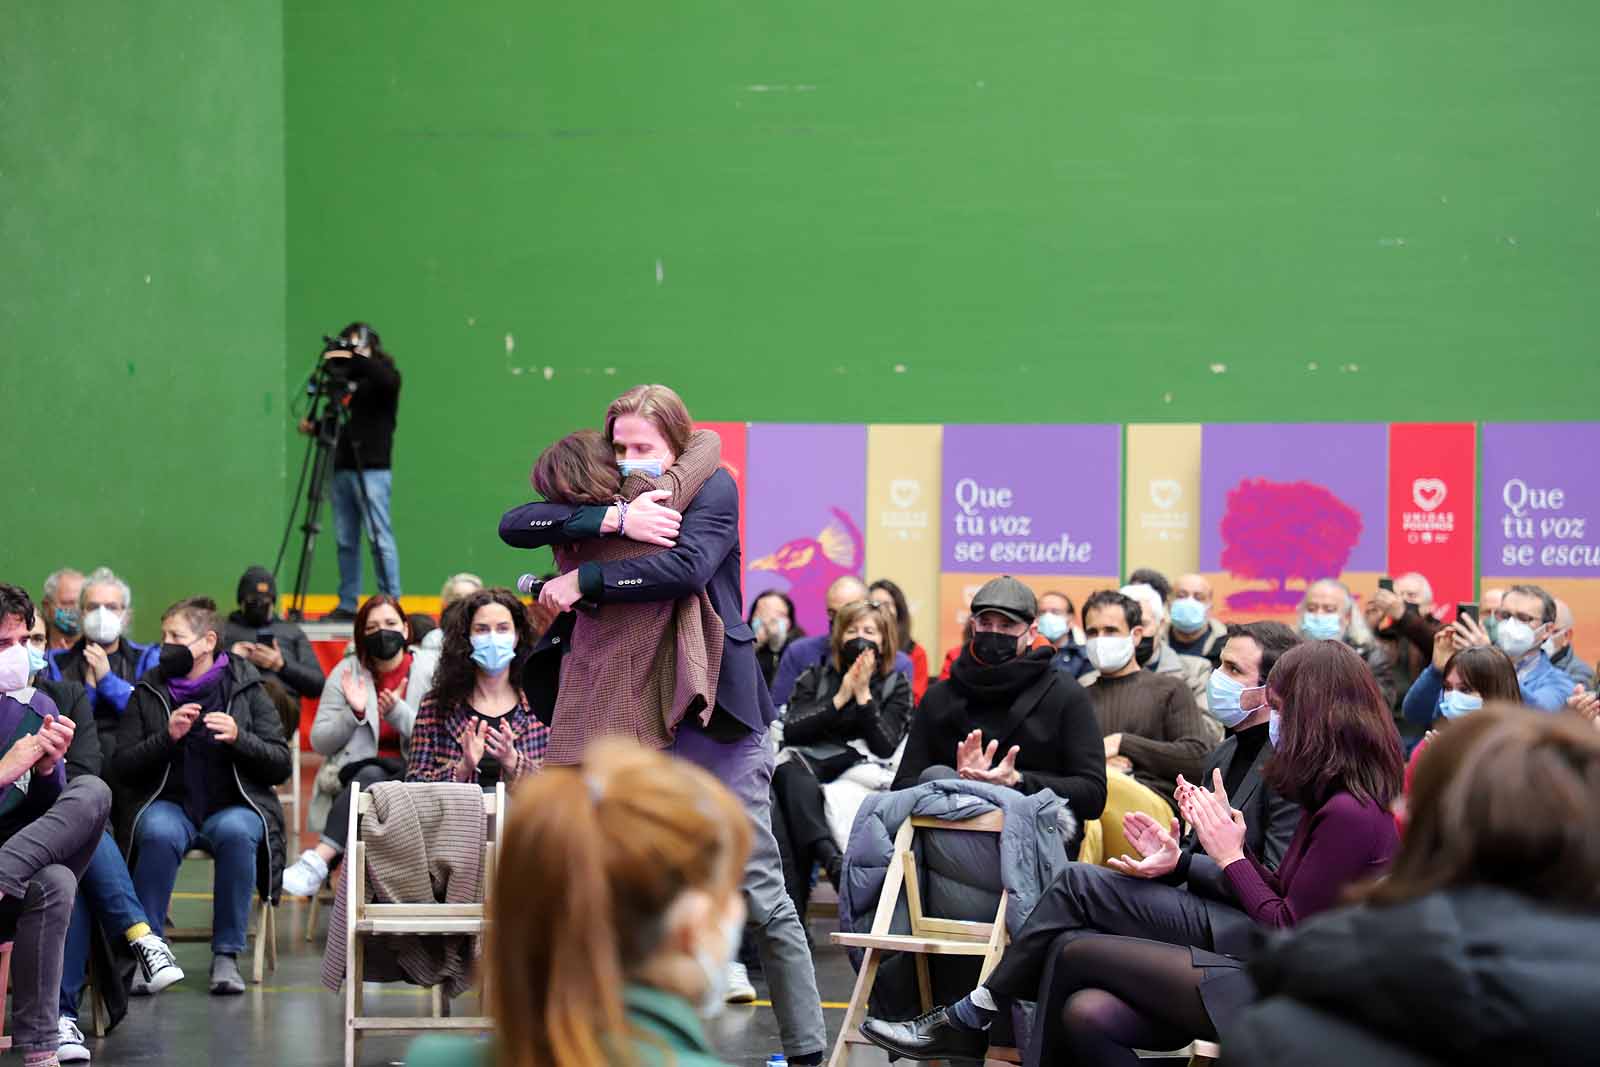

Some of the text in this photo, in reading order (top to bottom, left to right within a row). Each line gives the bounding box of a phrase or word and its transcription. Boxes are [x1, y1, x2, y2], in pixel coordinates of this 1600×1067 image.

[955, 478, 1013, 515] Que
[1503, 479, 1564, 516] Que
[955, 512, 985, 536] tu
[989, 515, 1032, 536] voz
[1540, 517, 1585, 538] voz
[955, 533, 1092, 562] se escuche
[1502, 543, 1534, 566] se
